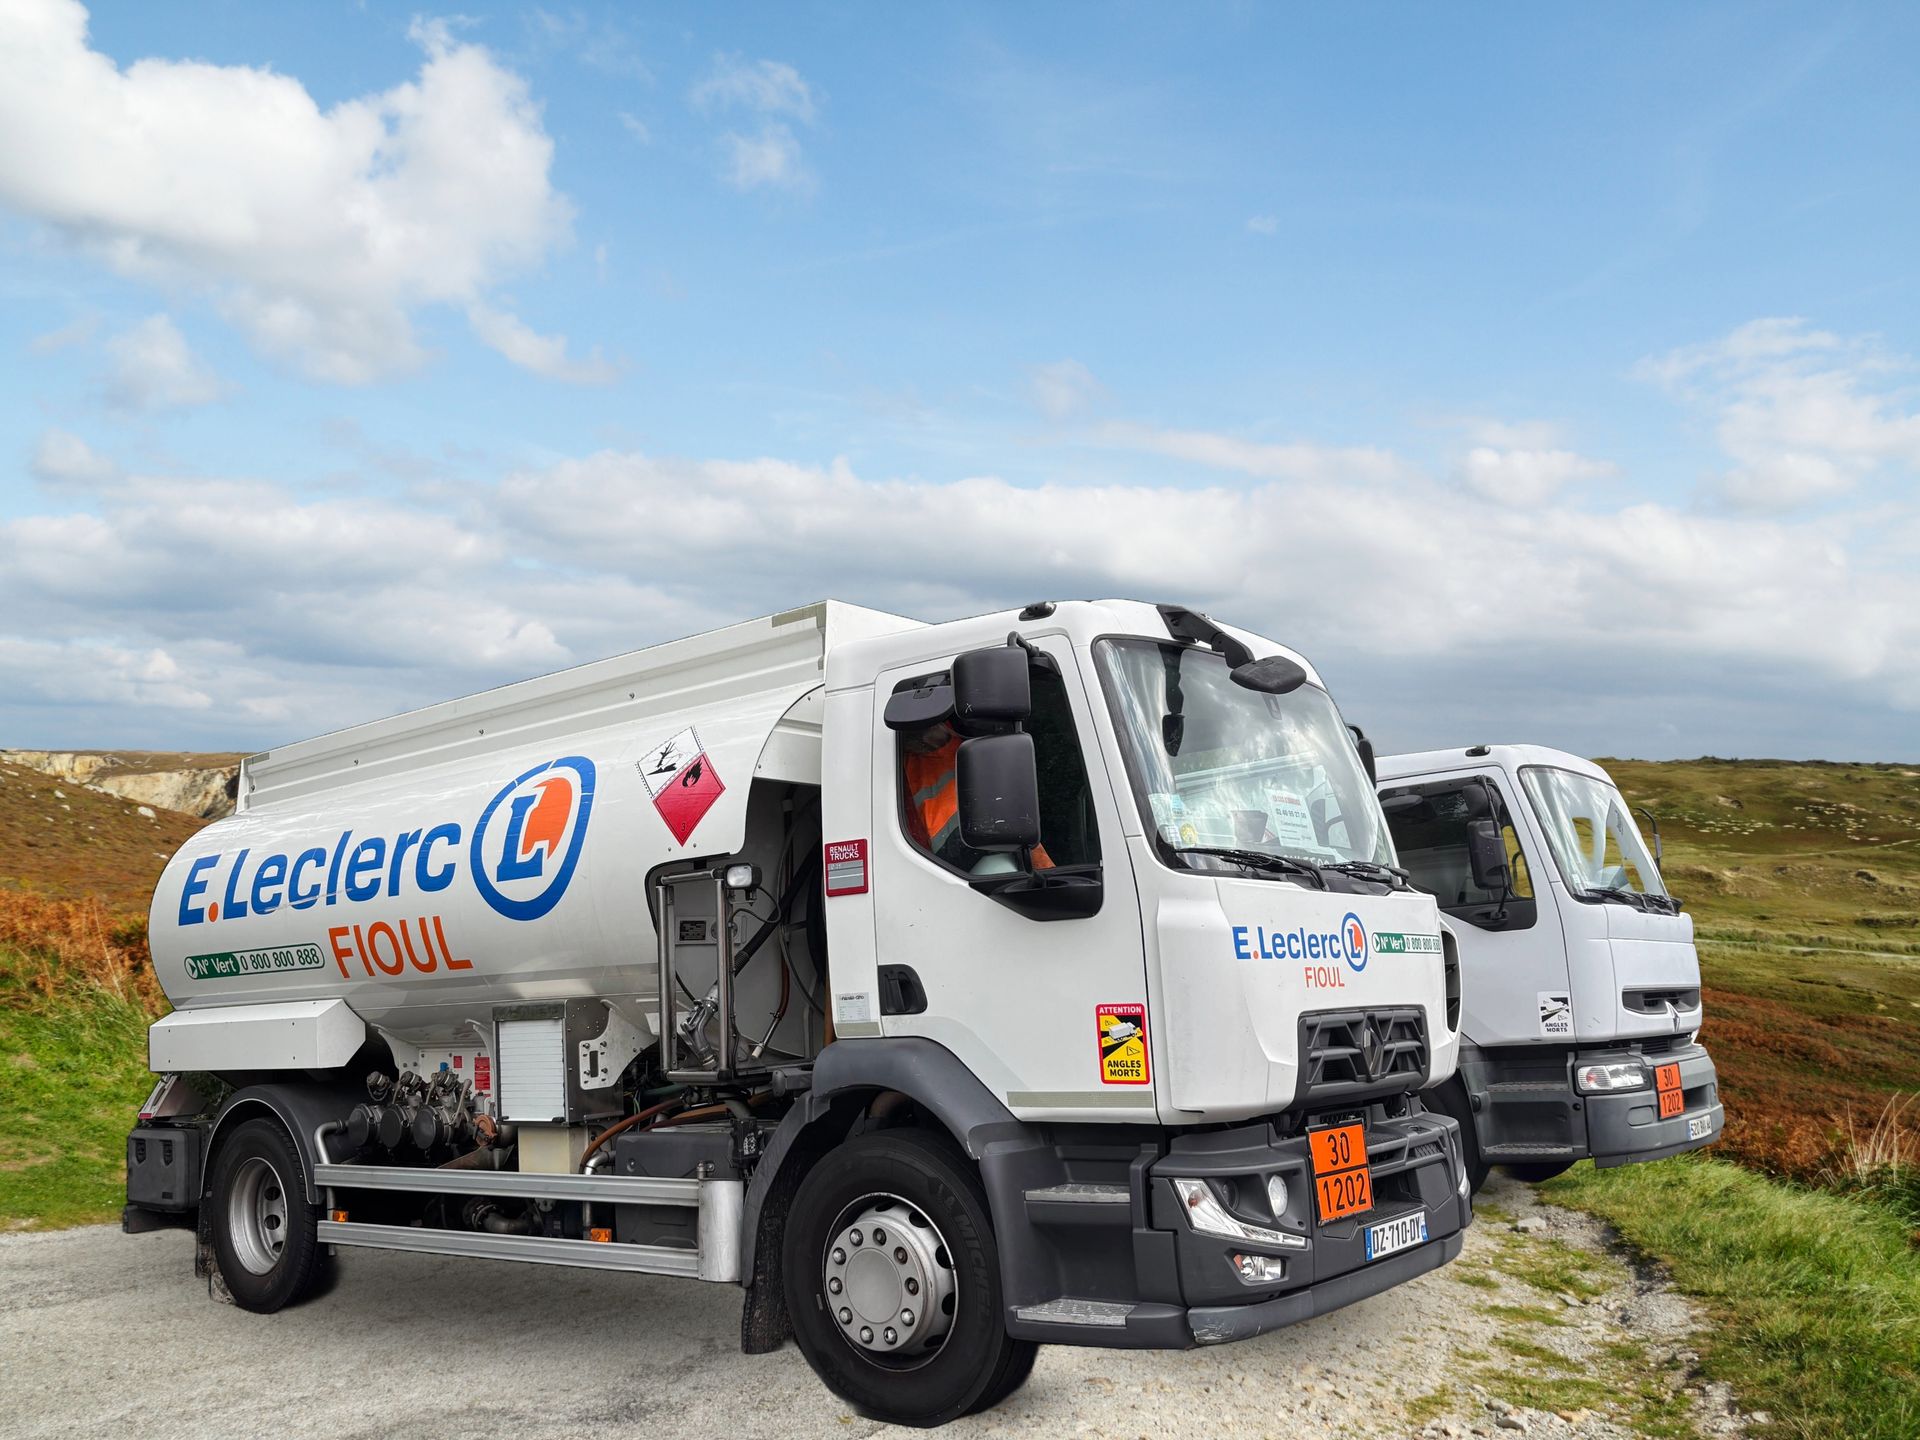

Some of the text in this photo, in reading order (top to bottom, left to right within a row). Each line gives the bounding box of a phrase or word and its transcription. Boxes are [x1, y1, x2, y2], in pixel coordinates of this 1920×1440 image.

[681, 822, 686, 832] 3
[829, 843, 859, 853] RENAULT
[830, 850, 860, 861] TRUCKS
[178, 822, 462, 926] E.Leclerc
[328, 915, 473, 978] FIOUL
[1232, 926, 1341, 959] E.Leclerc
[1389, 936, 1404, 950] Vert
[1406, 937, 1411, 950] 0
[197, 947, 320, 976] N° Vert 0 800 800 888
[1304, 966, 1345, 988] FIOUL
[1098, 1006, 1142, 1014] ATTENTION
[1107, 1060, 1141, 1068] ANGLES
[1110, 1069, 1141, 1077] MORTS
[1663, 1068, 1674, 1087] 30
[1662, 1092, 1681, 1114] 1202
[1327, 1131, 1350, 1166] 30
[1323, 1173, 1367, 1214] 1202
[1372, 1215, 1420, 1255] DZ-710-DY
